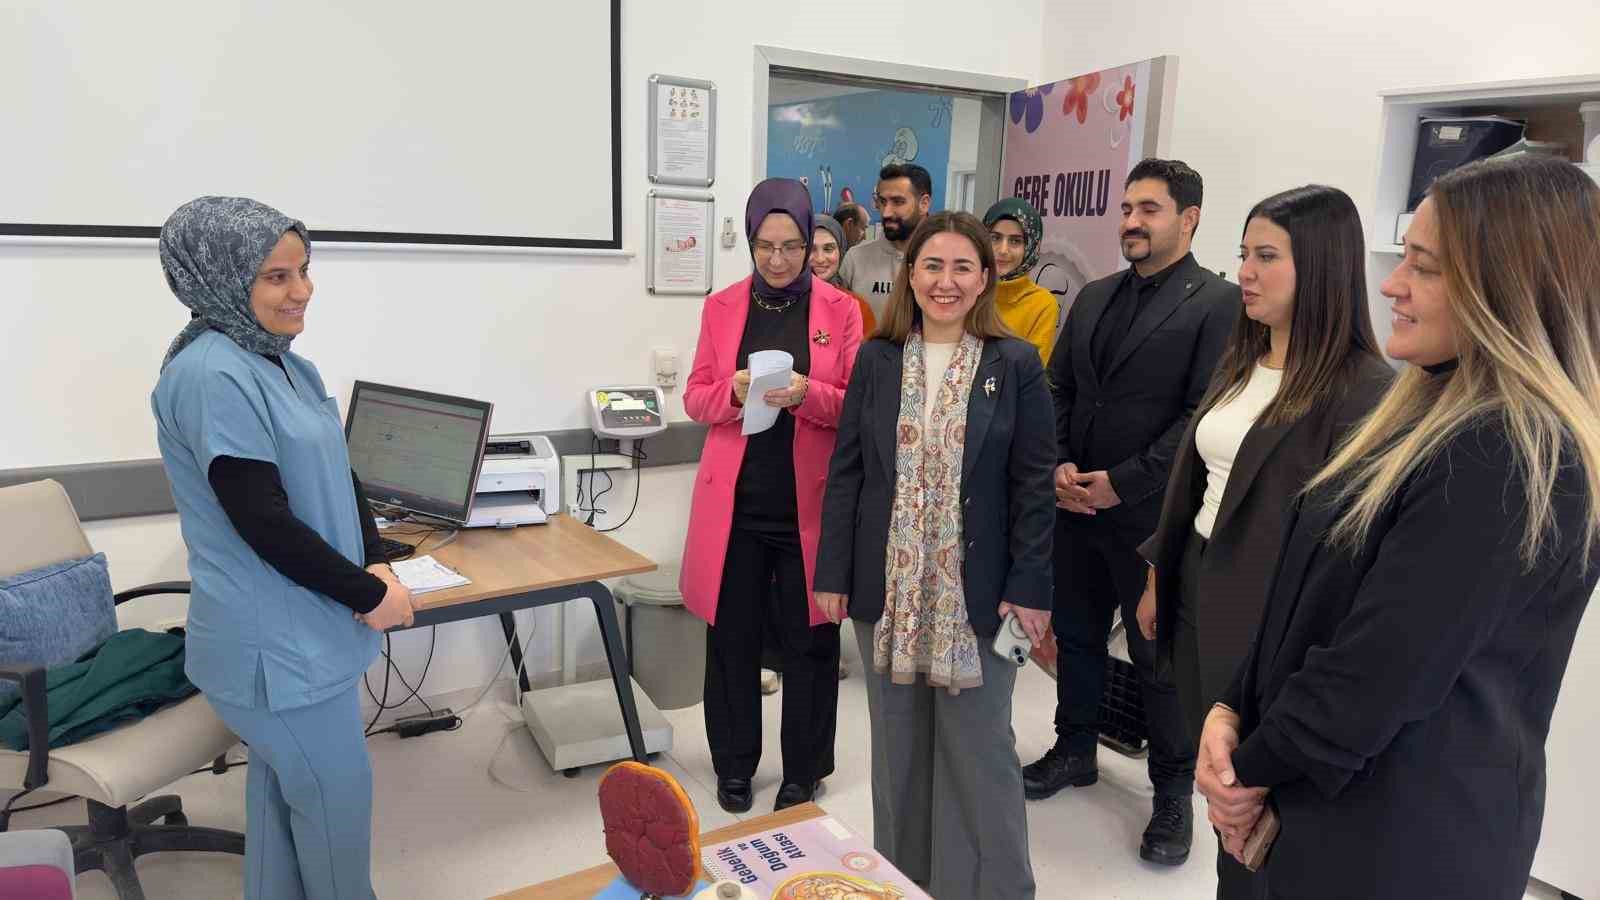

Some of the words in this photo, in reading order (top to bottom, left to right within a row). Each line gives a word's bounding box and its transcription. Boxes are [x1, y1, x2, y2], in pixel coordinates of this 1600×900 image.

[1053, 169, 1110, 217] OKULU
[716, 846, 759, 884] Gebelik
[737, 842, 749, 852] ve
[750, 838, 788, 872] Doğum
